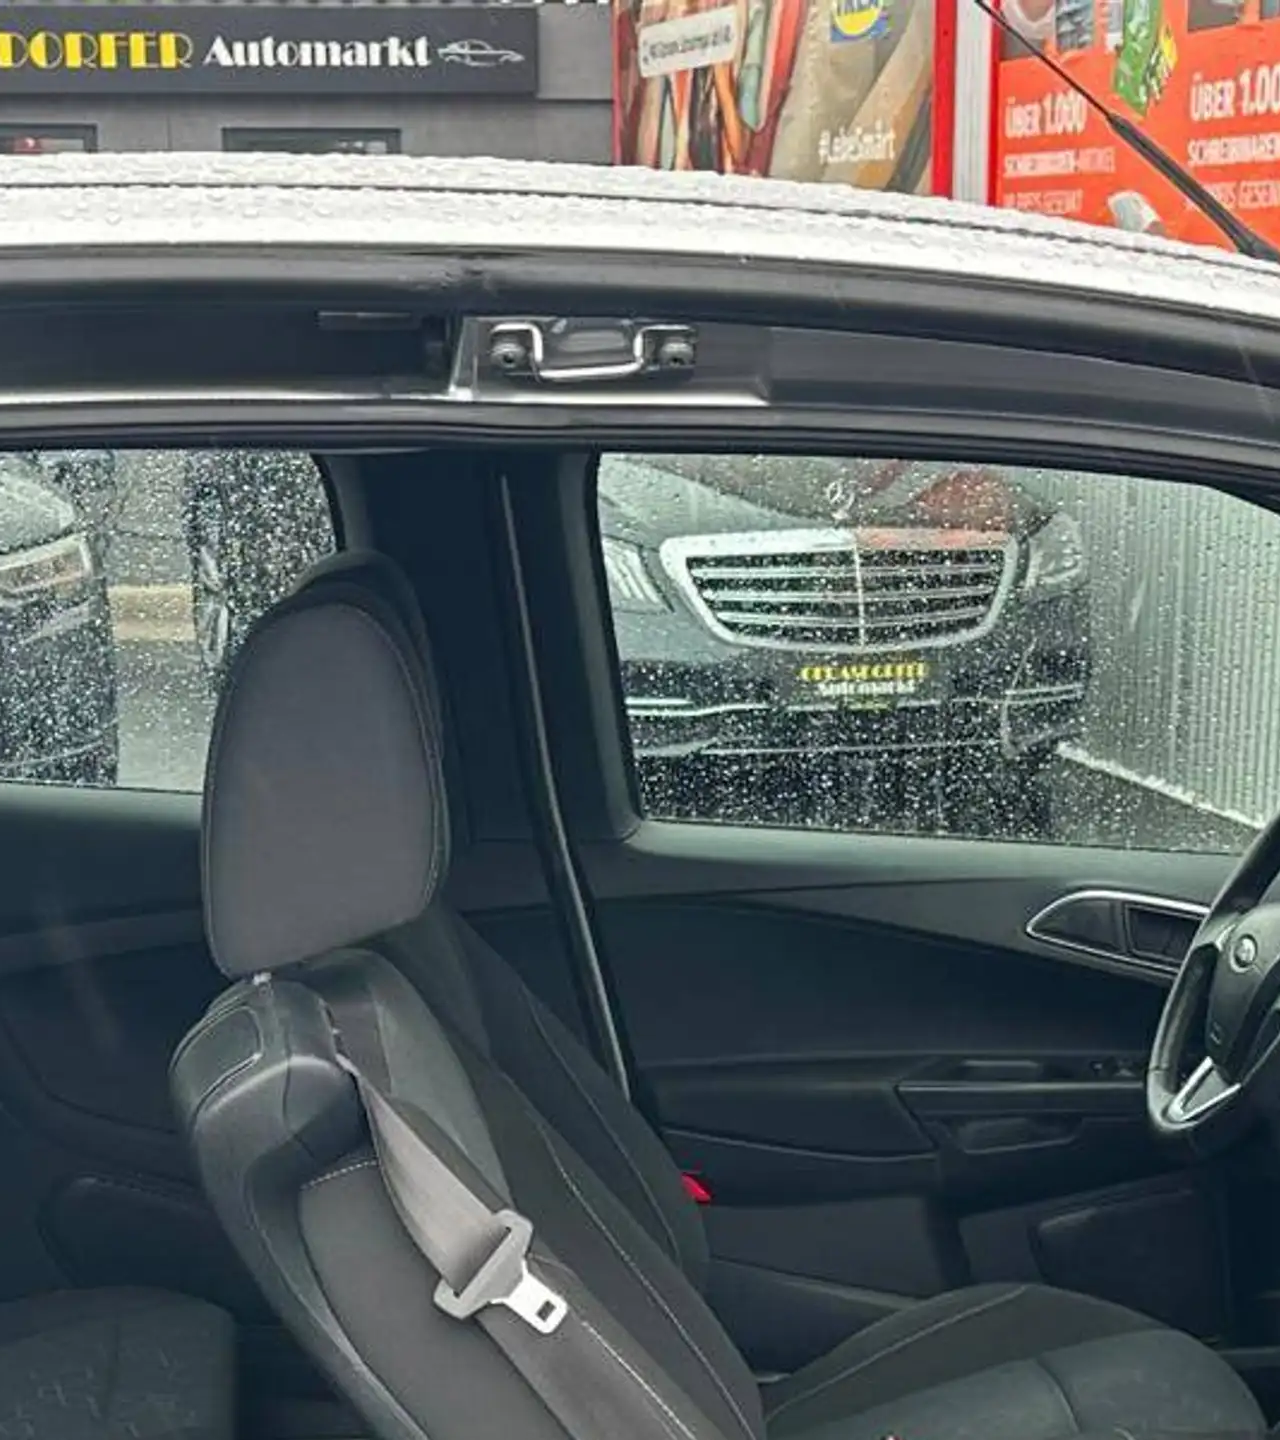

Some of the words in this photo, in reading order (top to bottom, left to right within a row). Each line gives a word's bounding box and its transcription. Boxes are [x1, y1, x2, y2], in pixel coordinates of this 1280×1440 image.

[202, 35, 432, 67] Automarkt
[1004, 95, 1041, 138] ÜBER
[1042, 88, 1088, 135] 1.000
[1190, 71, 1235, 121] ÜBER
